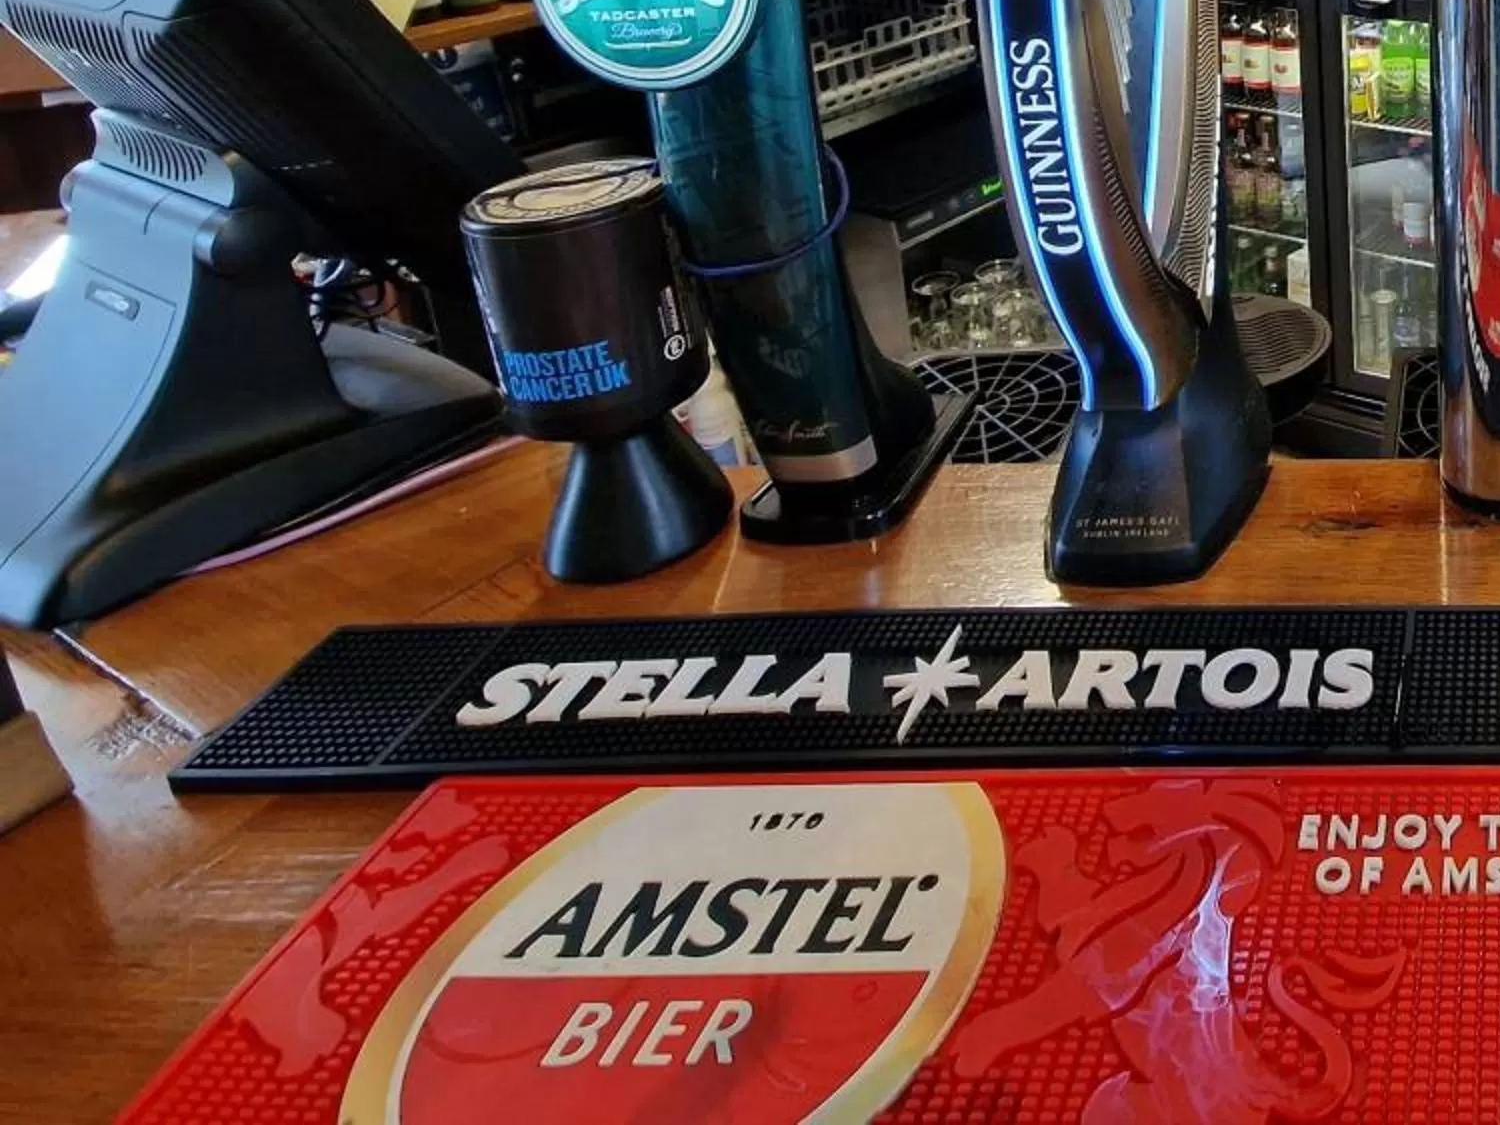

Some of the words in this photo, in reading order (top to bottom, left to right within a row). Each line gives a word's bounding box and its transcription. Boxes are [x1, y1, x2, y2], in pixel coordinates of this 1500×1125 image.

[590, 6, 695, 23] TADCASTER
[610, 22, 683, 41] Brewery
[1009, 37, 1084, 256] GUINNESS
[503, 340, 609, 377] PROSTATE
[509, 372, 594, 403] CANCER
[598, 360, 632, 392] UK
[454, 647, 853, 728] STELLA
[976, 646, 1377, 715] ARTOIS
[1298, 813, 1463, 851] ENJOY
[1314, 856, 1385, 895] OF
[503, 874, 920, 959] AMSTEL
[540, 1000, 753, 1068] BIER
